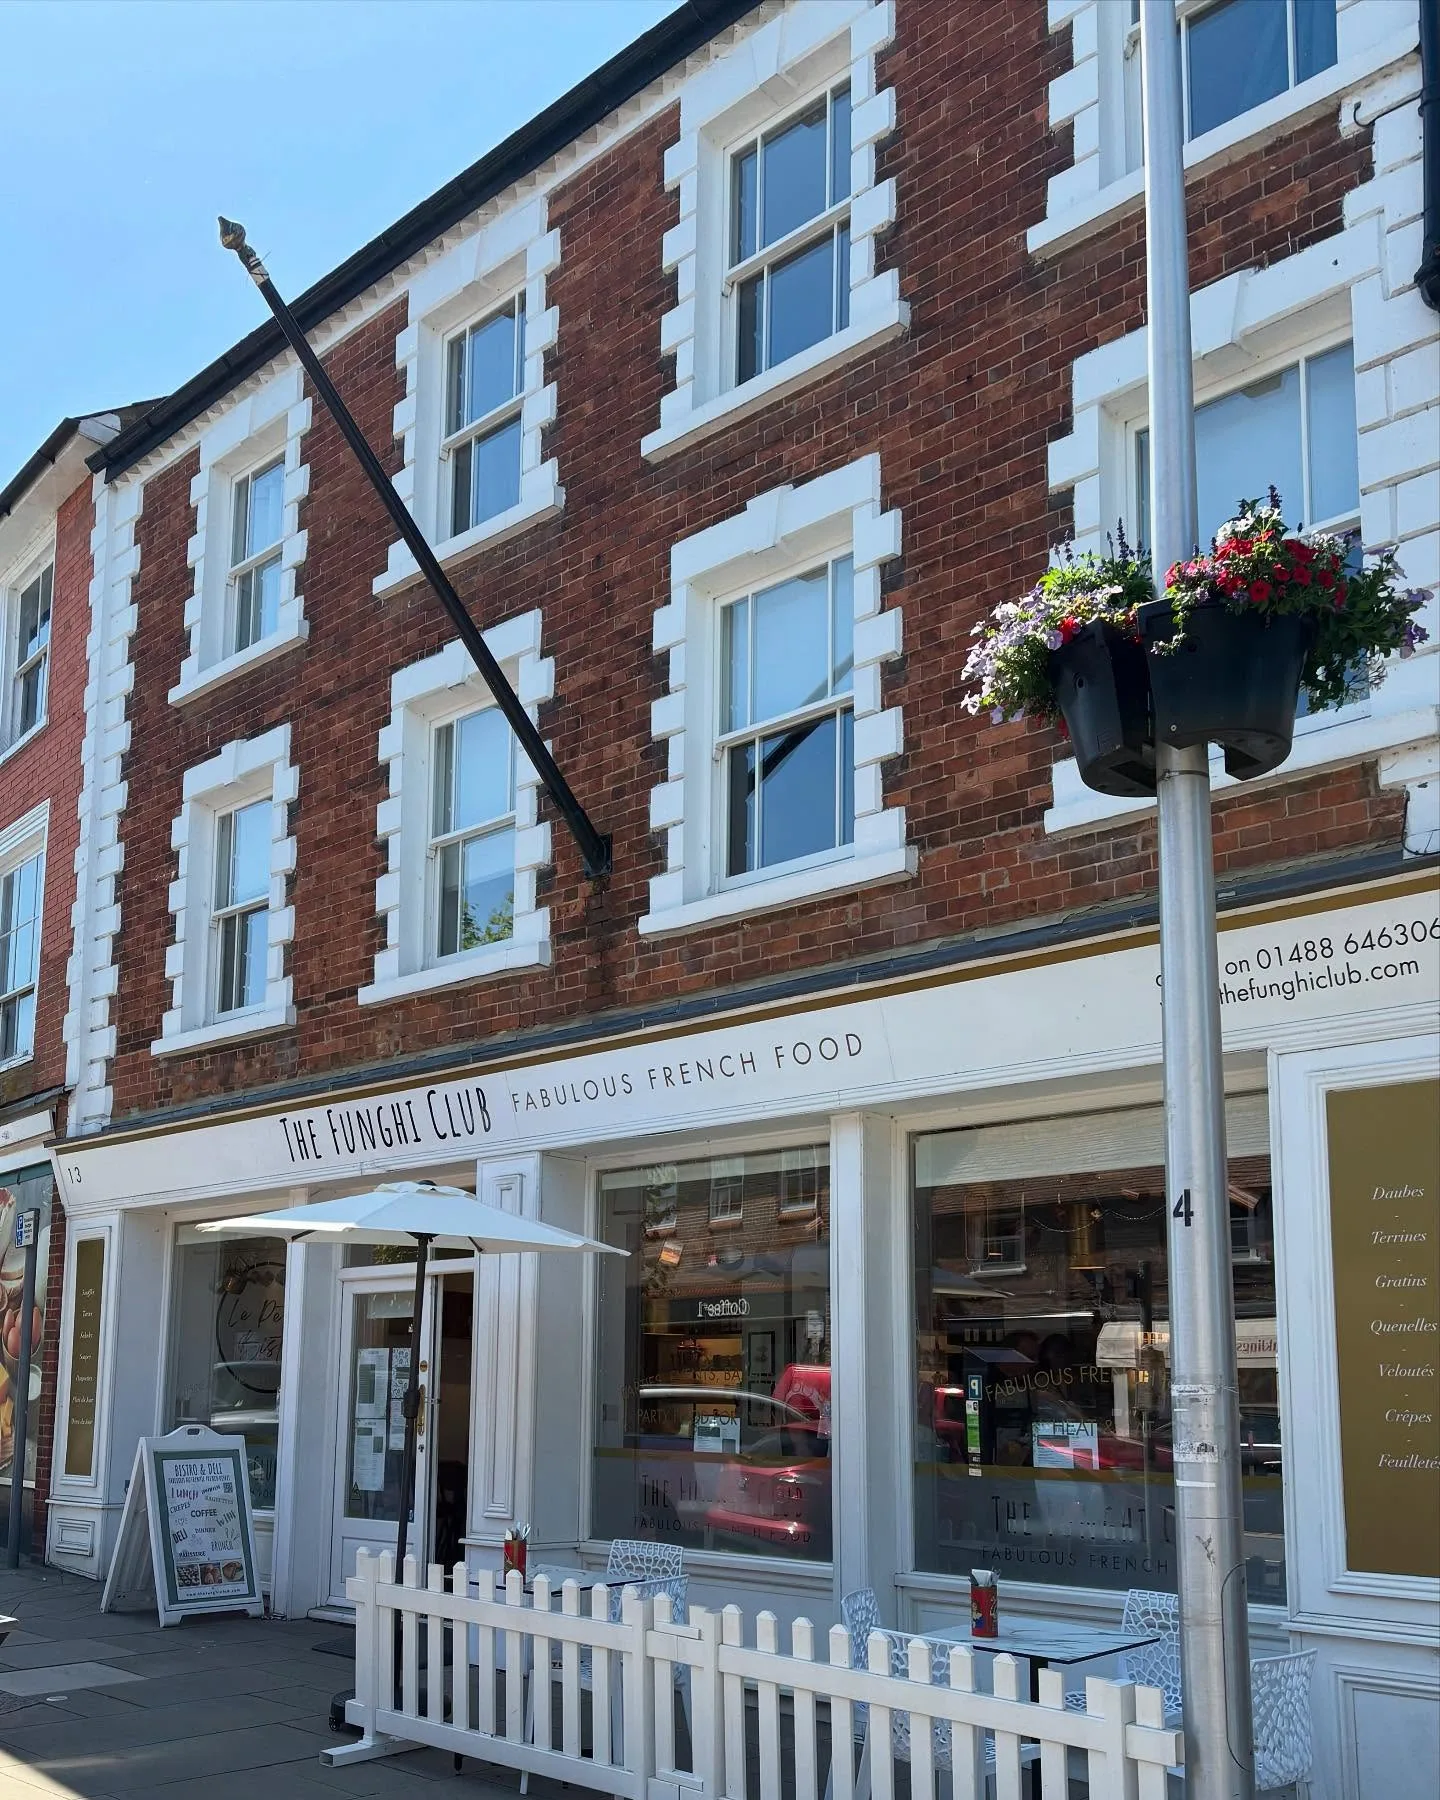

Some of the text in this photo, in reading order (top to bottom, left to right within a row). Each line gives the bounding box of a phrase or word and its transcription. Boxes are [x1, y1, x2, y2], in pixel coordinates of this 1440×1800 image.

[1224, 917, 1440, 976] on 01488 646306
[1219, 959, 1420, 1006] thefunghiclub.com
[511, 1033, 863, 1113] FABULOUS FRENCH FOOD
[279, 1087, 492, 1162] THE FUNGHI CLUB
[67, 1166, 82, 1184] 13
[1372, 1184, 1425, 1200] Daubes
[1172, 1188, 1194, 1227] 4
[1371, 1229, 1428, 1244] Terrines
[1375, 1273, 1428, 1288] Gratins
[228, 1298, 251, 1328] Le
[1370, 1317, 1438, 1336] Quenelles
[1379, 1363, 1435, 1377] Veloutés
[985, 1367, 1073, 1403] FABULOUS
[1052, 1421, 1098, 1437] HEAT
[1385, 1408, 1433, 1427] Crêpes
[174, 1462, 223, 1477] BISTRO & DELI
[641, 1475, 670, 1509] THE
[190, 1508, 218, 1518] COFFEE
[991, 1495, 1032, 1536] THE
[982, 1546, 1169, 1576] FABULOUS FRENCH
